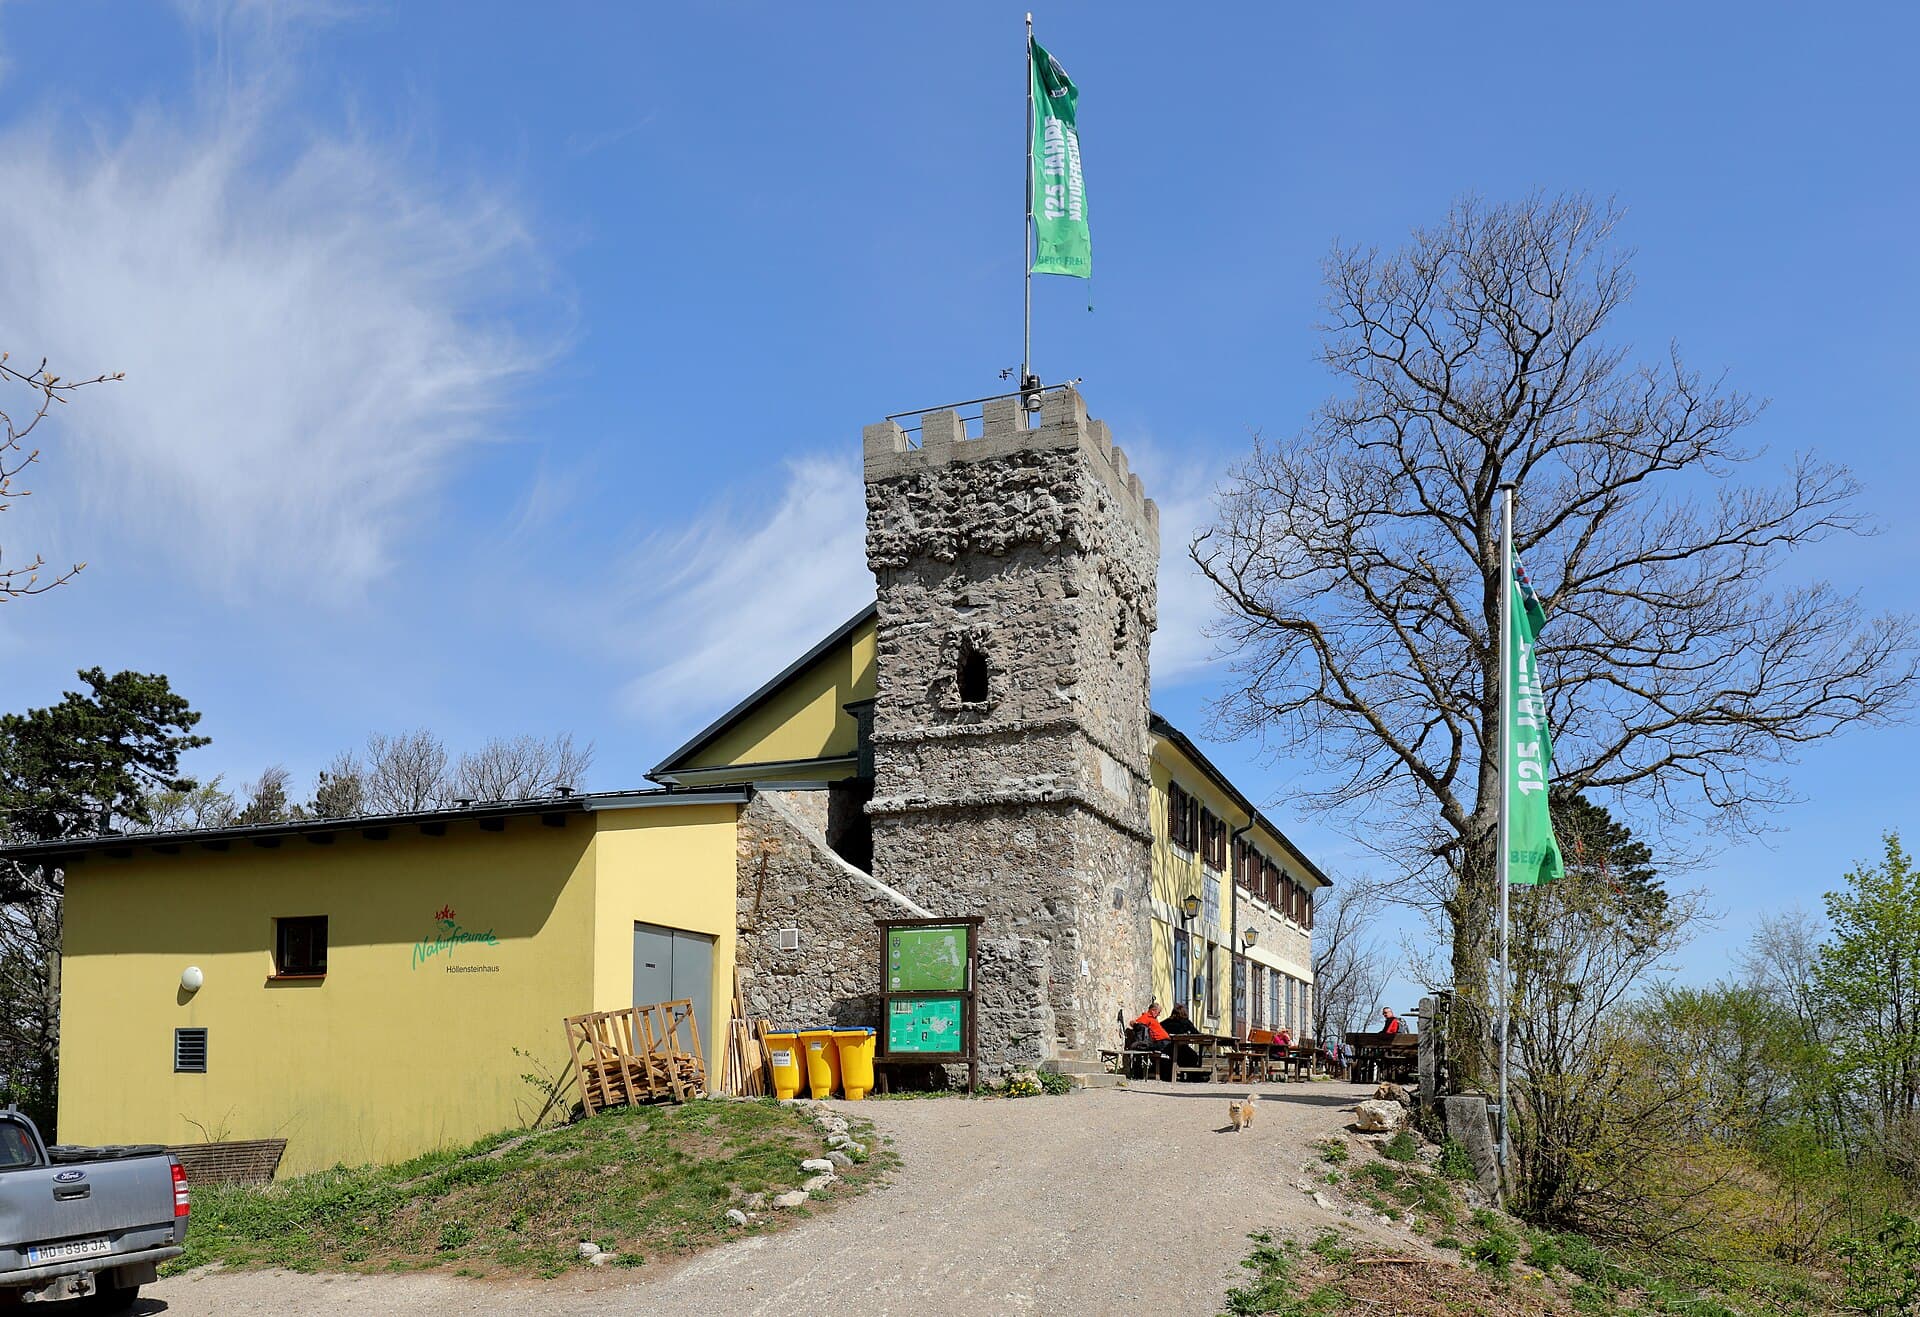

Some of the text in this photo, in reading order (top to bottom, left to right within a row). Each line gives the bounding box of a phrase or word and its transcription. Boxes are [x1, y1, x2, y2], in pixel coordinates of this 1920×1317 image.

[1044, 184, 1065, 221] 125
[1516, 741, 1544, 796] 125
[411, 926, 500, 971] Naturfreunde
[446, 965, 500, 974] Höllensteinhaus
[39, 1246, 57, 1259] MD
[90, 1239, 107, 1251] JA
